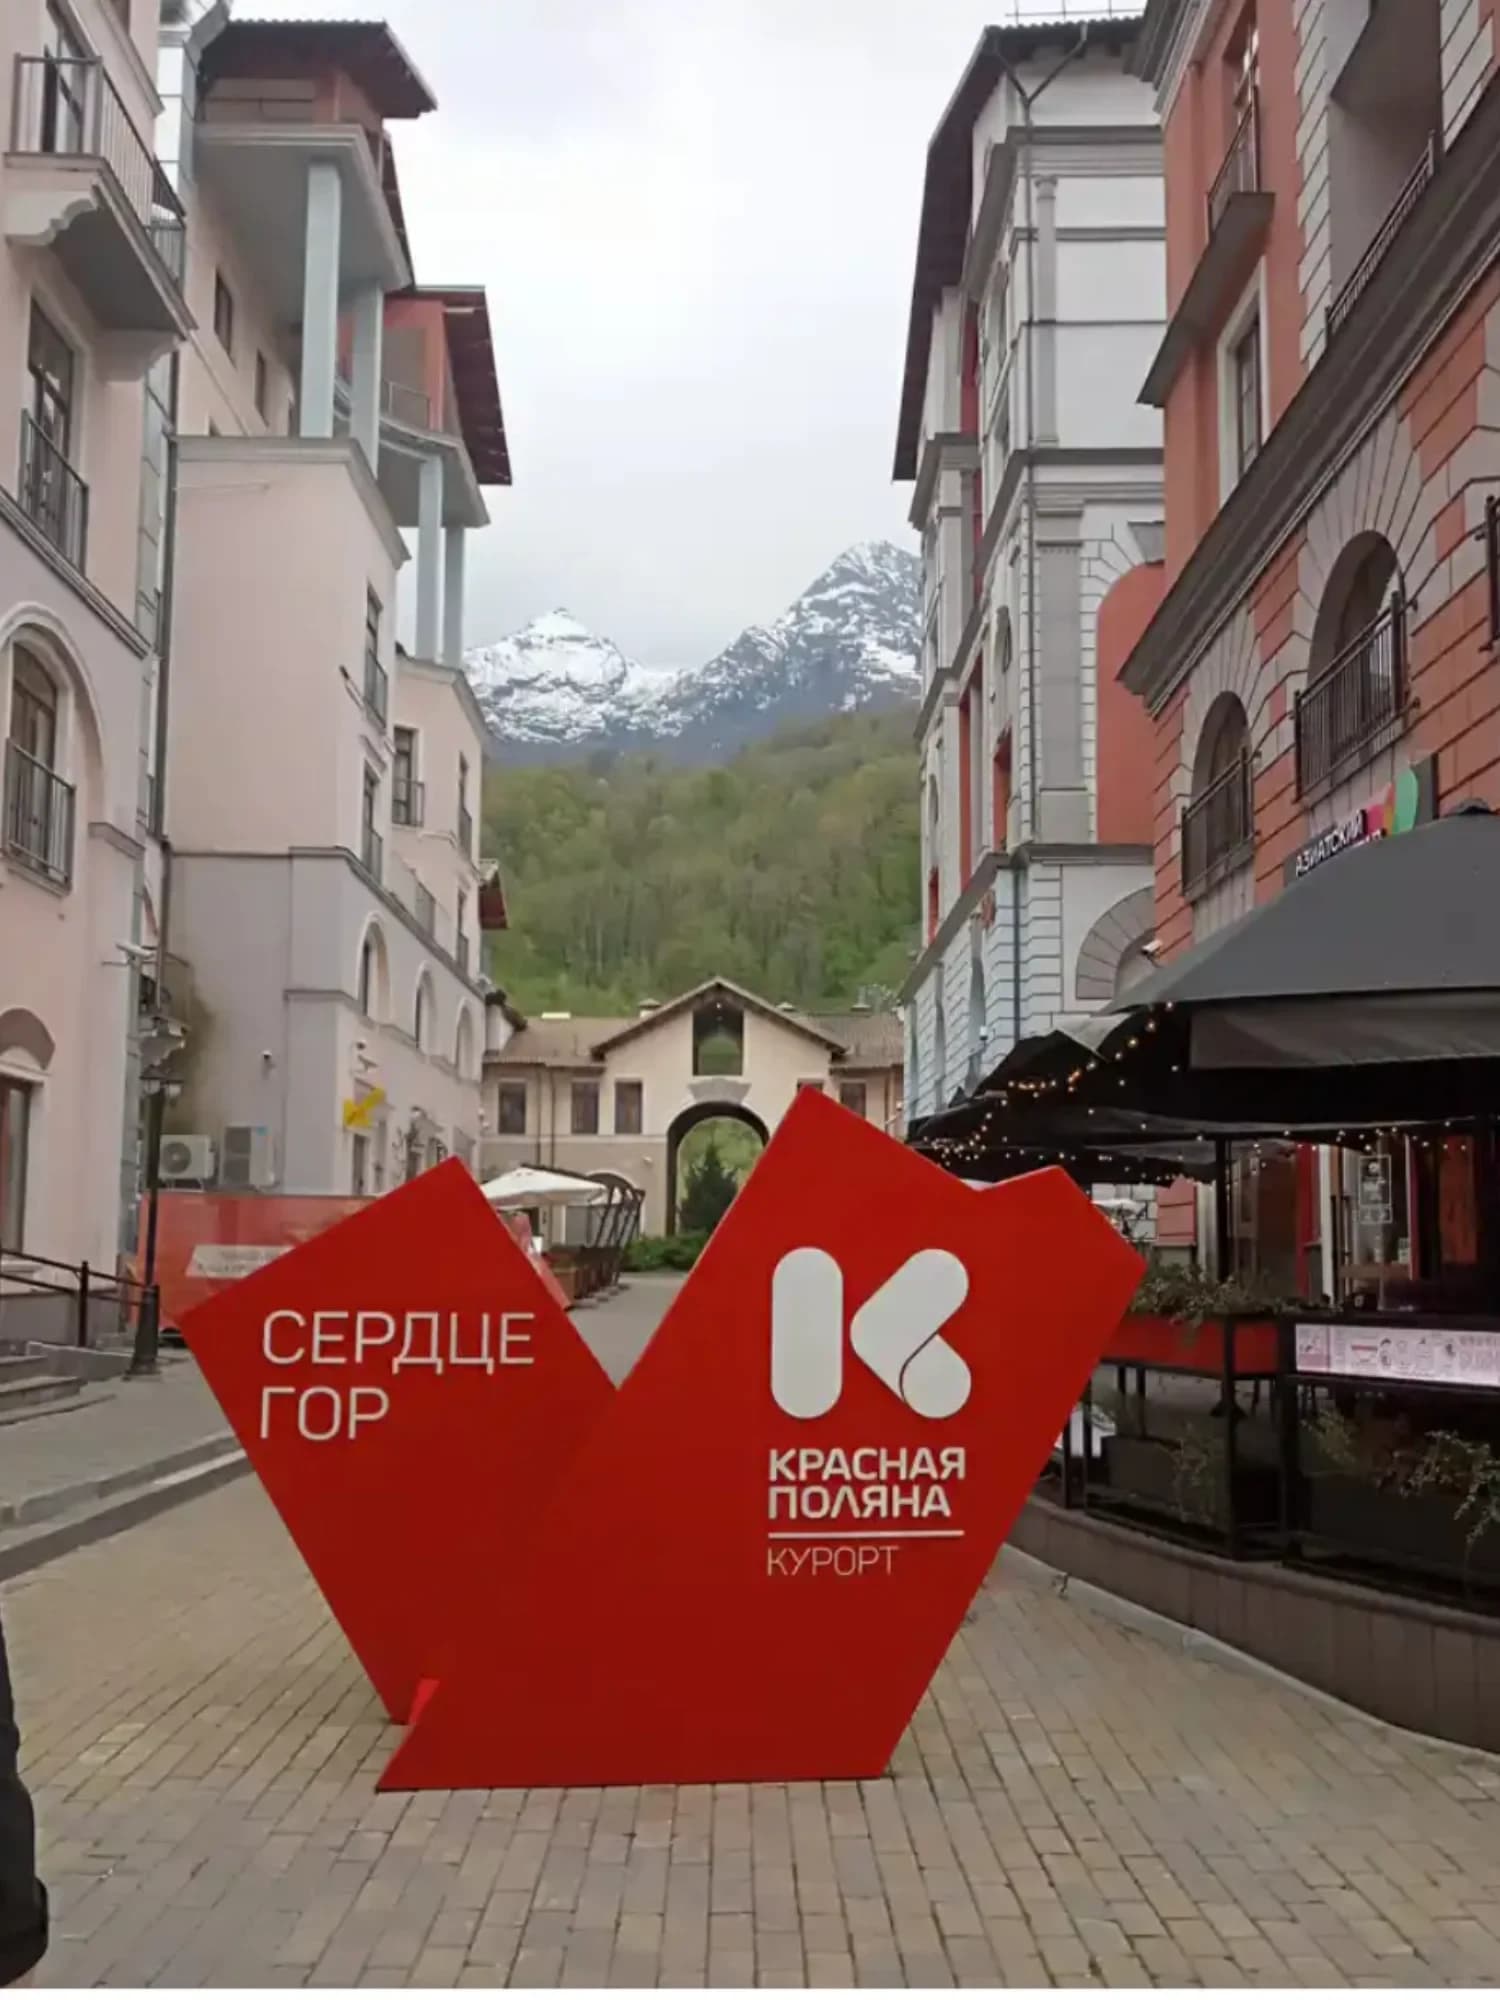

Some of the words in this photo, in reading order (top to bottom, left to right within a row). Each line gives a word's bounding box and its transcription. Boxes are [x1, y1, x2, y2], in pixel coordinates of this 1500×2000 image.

[262, 1309, 535, 1375] СЕРДЦЕ
[259, 1386, 390, 1441] ГОР
[768, 1447, 966, 1482] КРАСНАЯ
[768, 1484, 952, 1519] ПОЛЯНА
[766, 1545, 900, 1577] КУРОРТ
